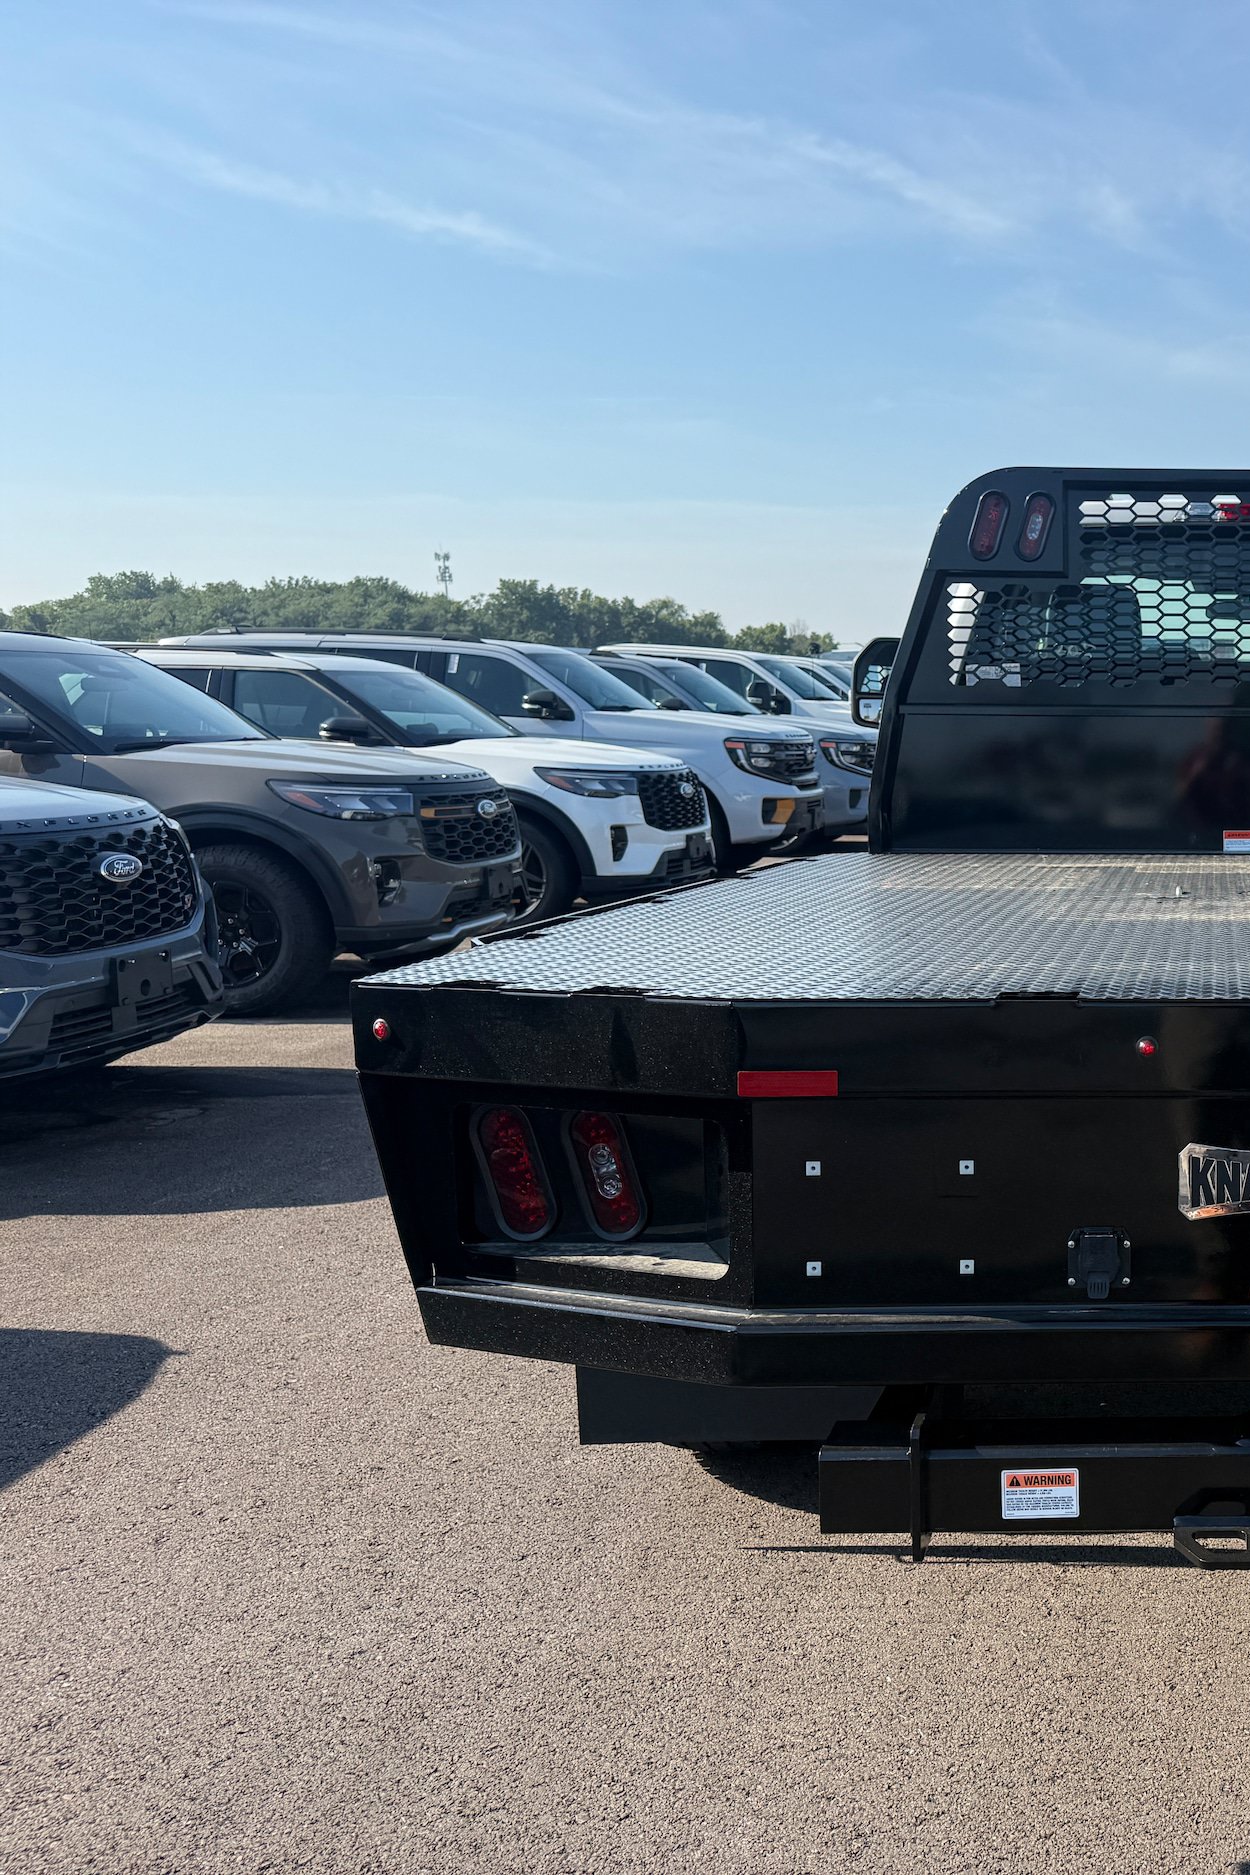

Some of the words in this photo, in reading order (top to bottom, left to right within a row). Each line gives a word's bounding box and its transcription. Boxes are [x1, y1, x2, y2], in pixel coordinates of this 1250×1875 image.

[0, 809, 147, 831] XPLORER
[113, 859, 135, 876] Ford
[1023, 1475, 1072, 1486] WARNING
